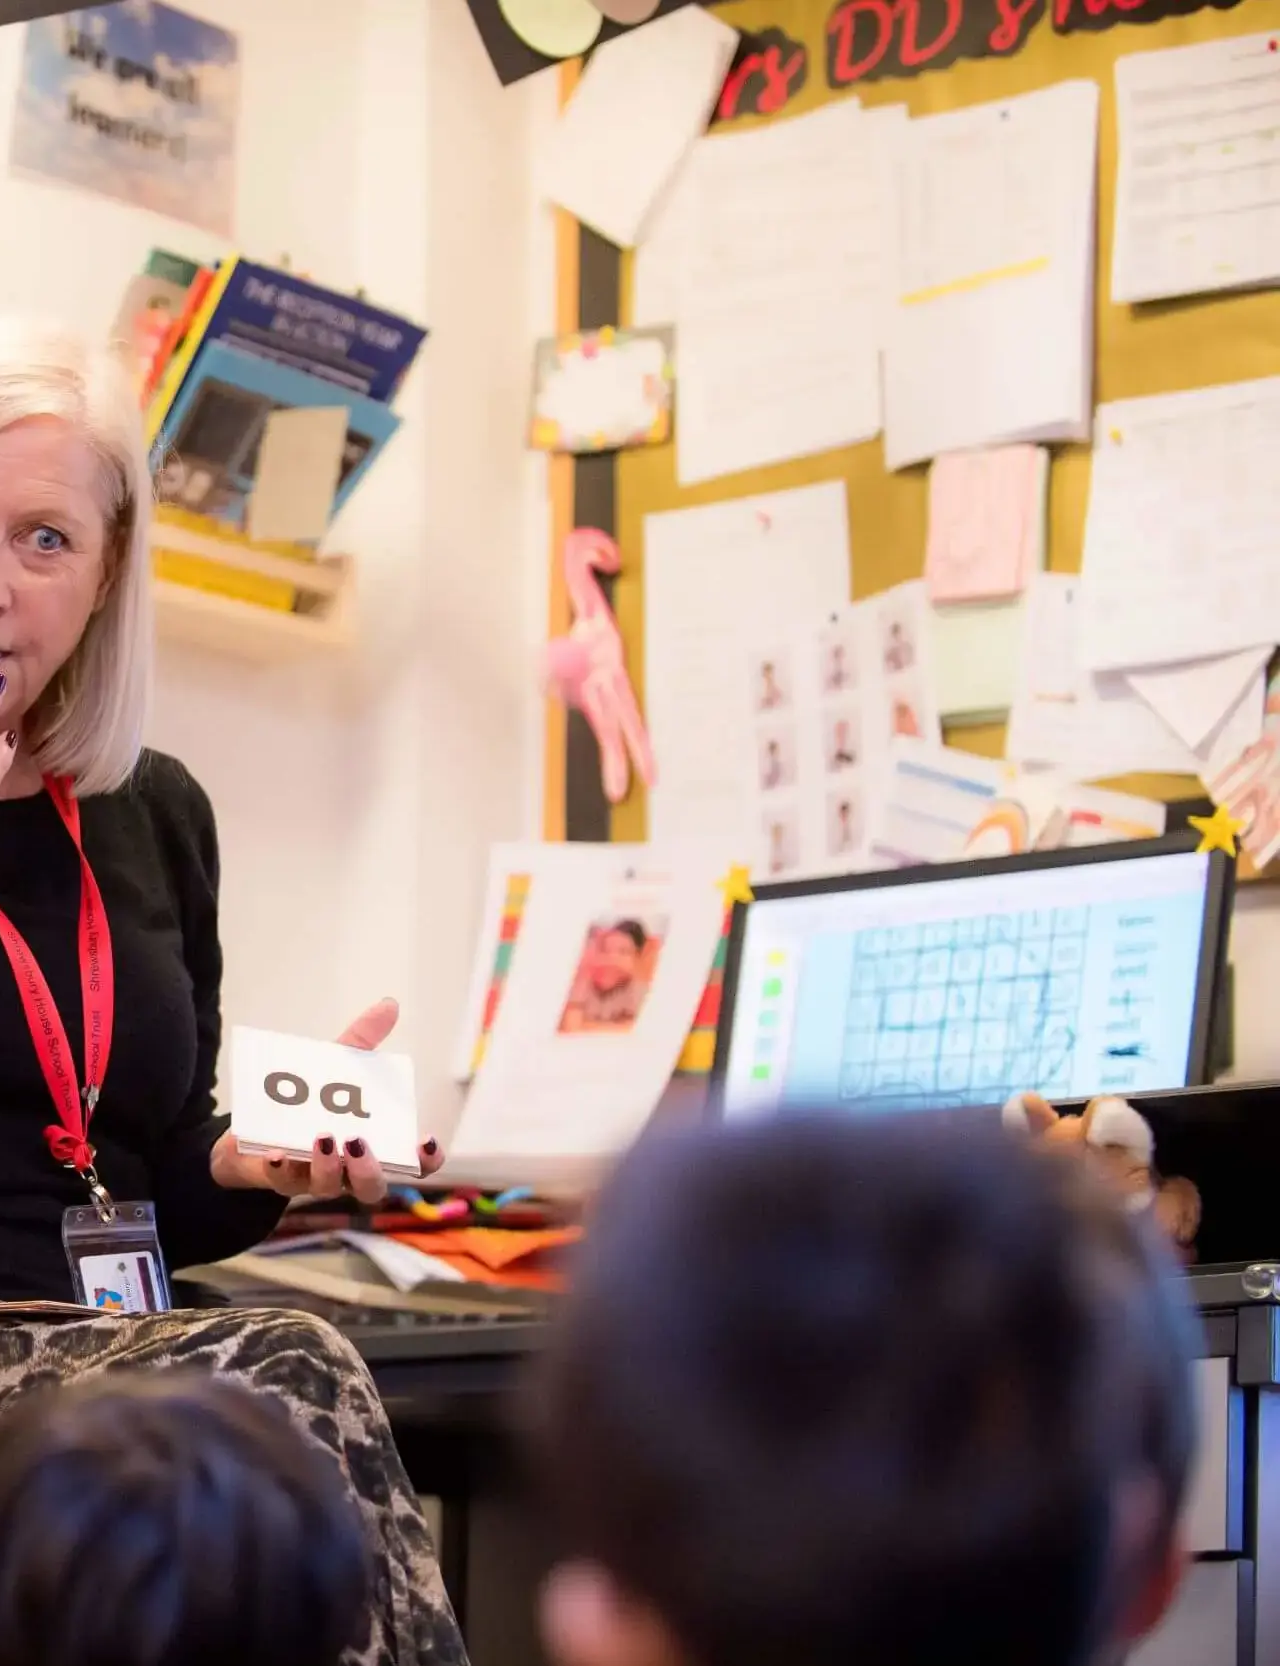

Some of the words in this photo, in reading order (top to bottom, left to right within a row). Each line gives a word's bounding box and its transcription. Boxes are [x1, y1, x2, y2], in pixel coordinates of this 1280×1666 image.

[87, 931, 100, 992] Shrewsbury
[7, 931, 40, 996] Shrewsbury
[35, 996, 52, 1036] House
[48, 1037, 64, 1077] School
[59, 1074, 74, 1112] Trust
[264, 1071, 371, 1118] oa
